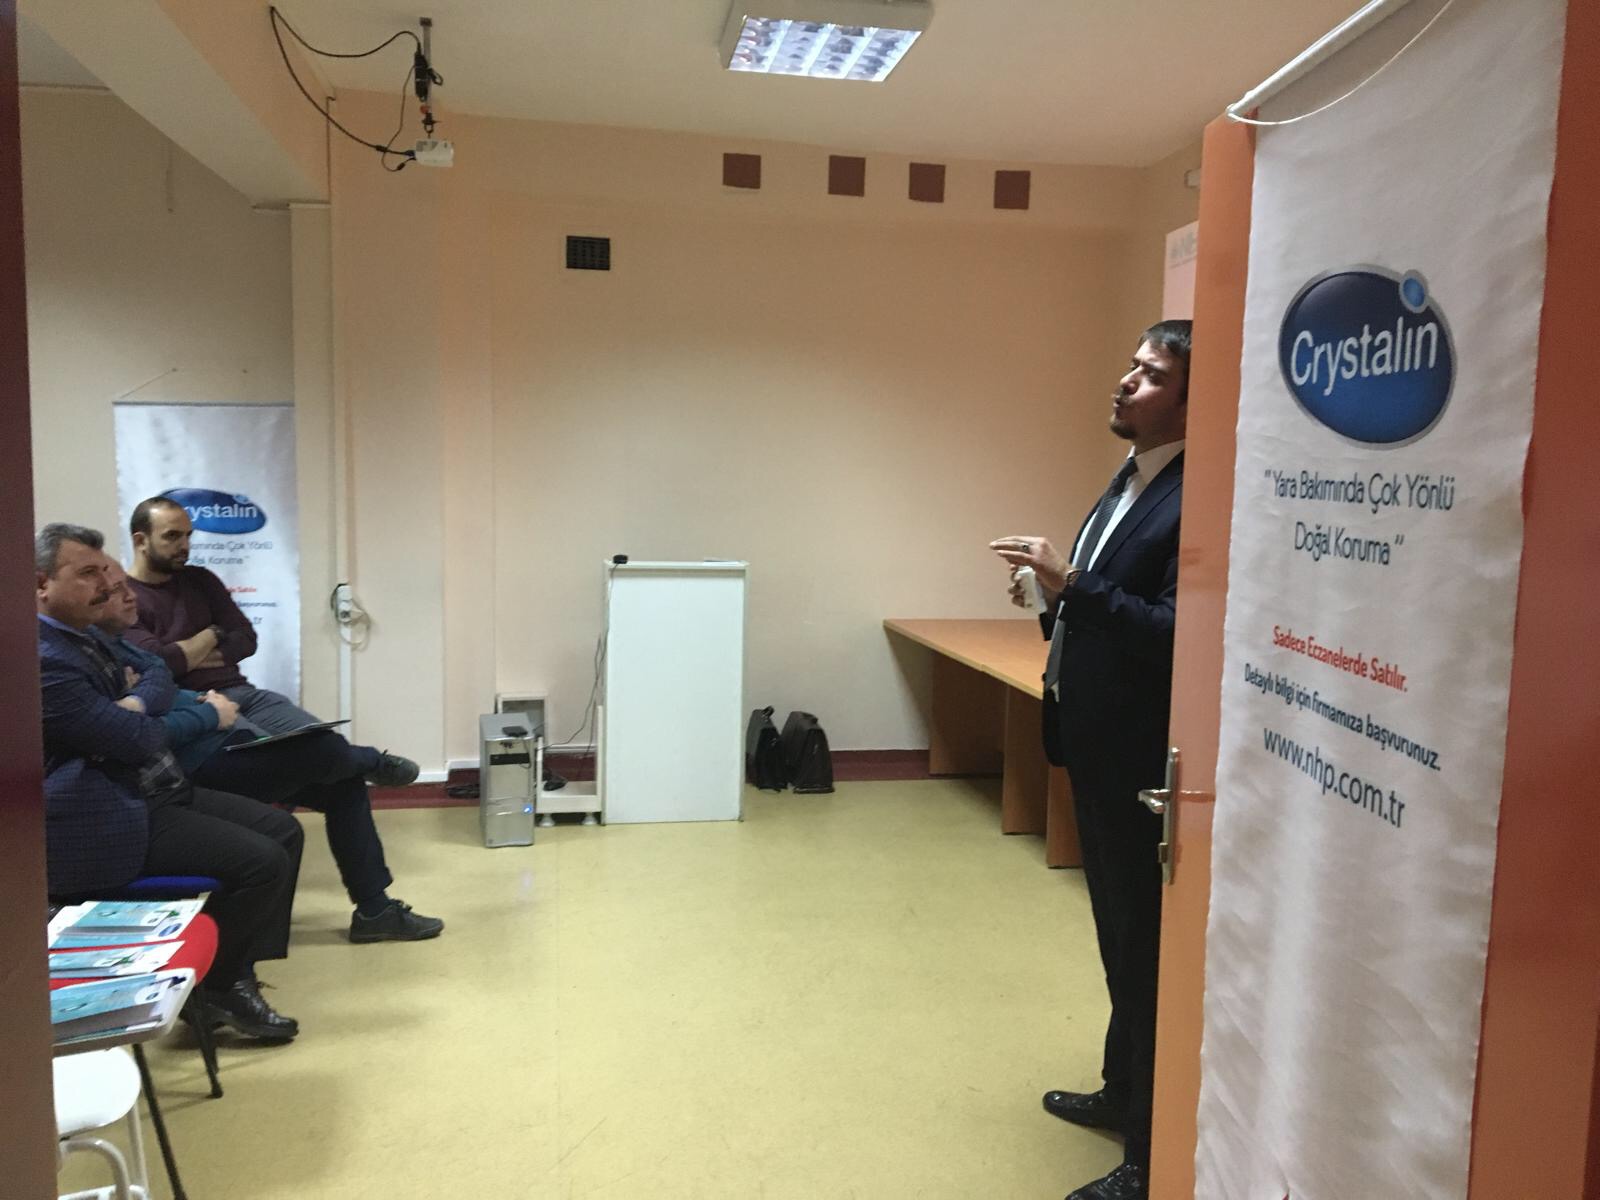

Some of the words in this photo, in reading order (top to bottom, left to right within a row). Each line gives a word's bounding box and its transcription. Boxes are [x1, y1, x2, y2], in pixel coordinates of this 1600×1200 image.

[1300, 470, 1365, 504] Bakımında
[1368, 472, 1401, 514] Çok
[1405, 474, 1455, 511] Yönlü
[1294, 521, 1331, 561] Doğal
[1273, 625, 1305, 655] Sadece
[1307, 636, 1367, 678] Eczanelerde
[1370, 657, 1408, 692] Satılır.
[1244, 663, 1274, 694] Detaylı
[1275, 674, 1295, 705] bilgi
[1296, 684, 1311, 711] için
[1311, 691, 1363, 734] firmamıza
[1365, 713, 1441, 771] başvurunuz.
[1263, 728, 1405, 828] www.nhp.com.tr
